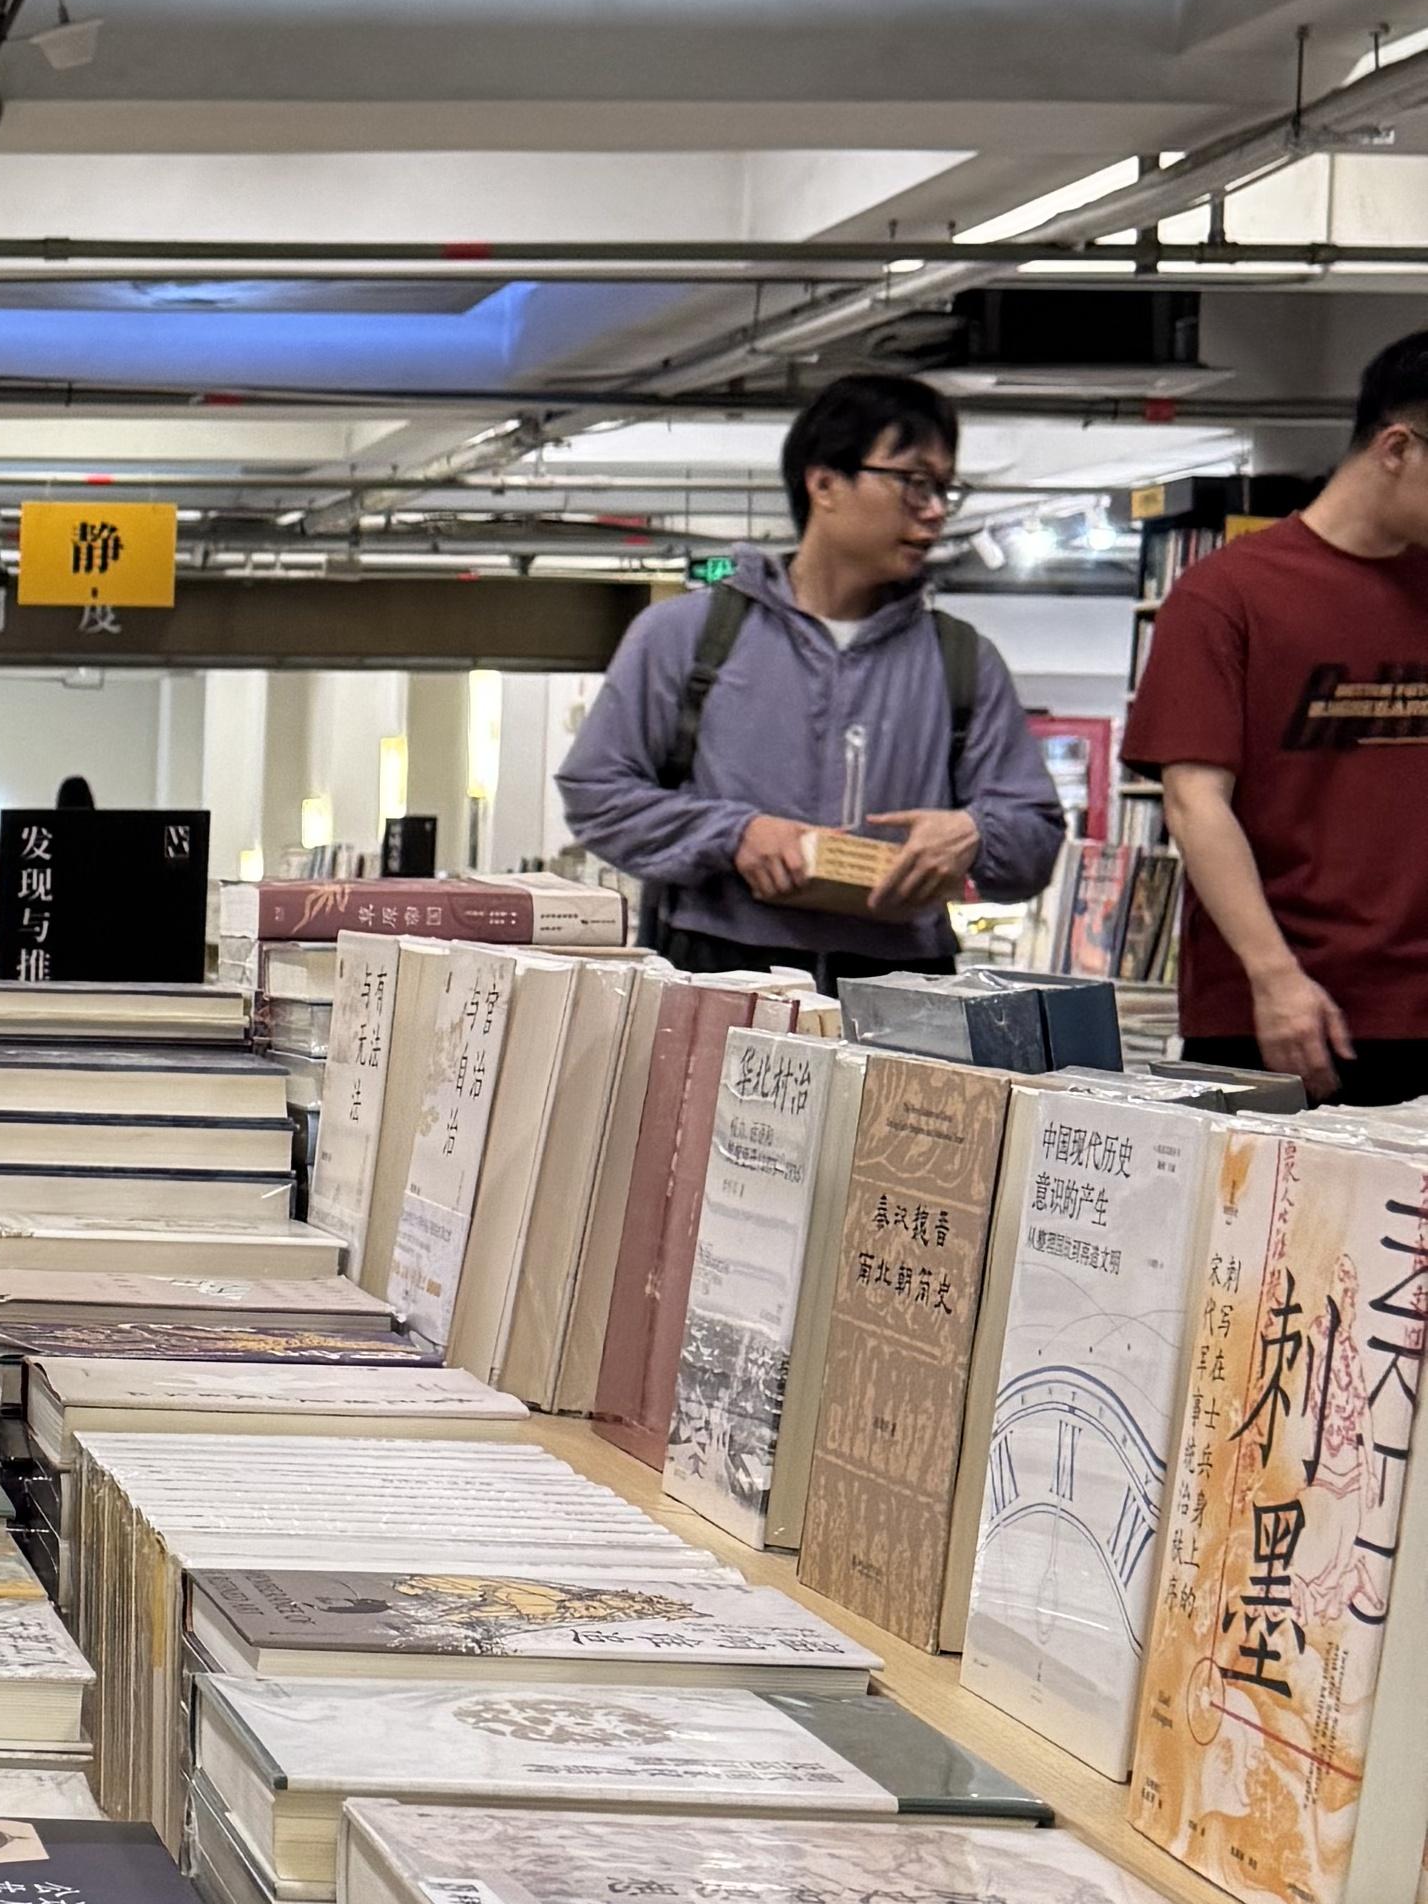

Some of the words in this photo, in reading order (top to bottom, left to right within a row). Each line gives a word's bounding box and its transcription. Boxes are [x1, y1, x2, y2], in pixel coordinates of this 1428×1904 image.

[72, 522, 123, 574] 静
[735, 1046, 812, 1115] 华北村治
[1042, 1120, 1133, 1179] 中国现代历史
[872, 1193, 952, 1248] 秦汉魏晋
[1031, 1171, 1110, 1228] 意识的产生
[1217, 1266, 1342, 1698] 刺墨
